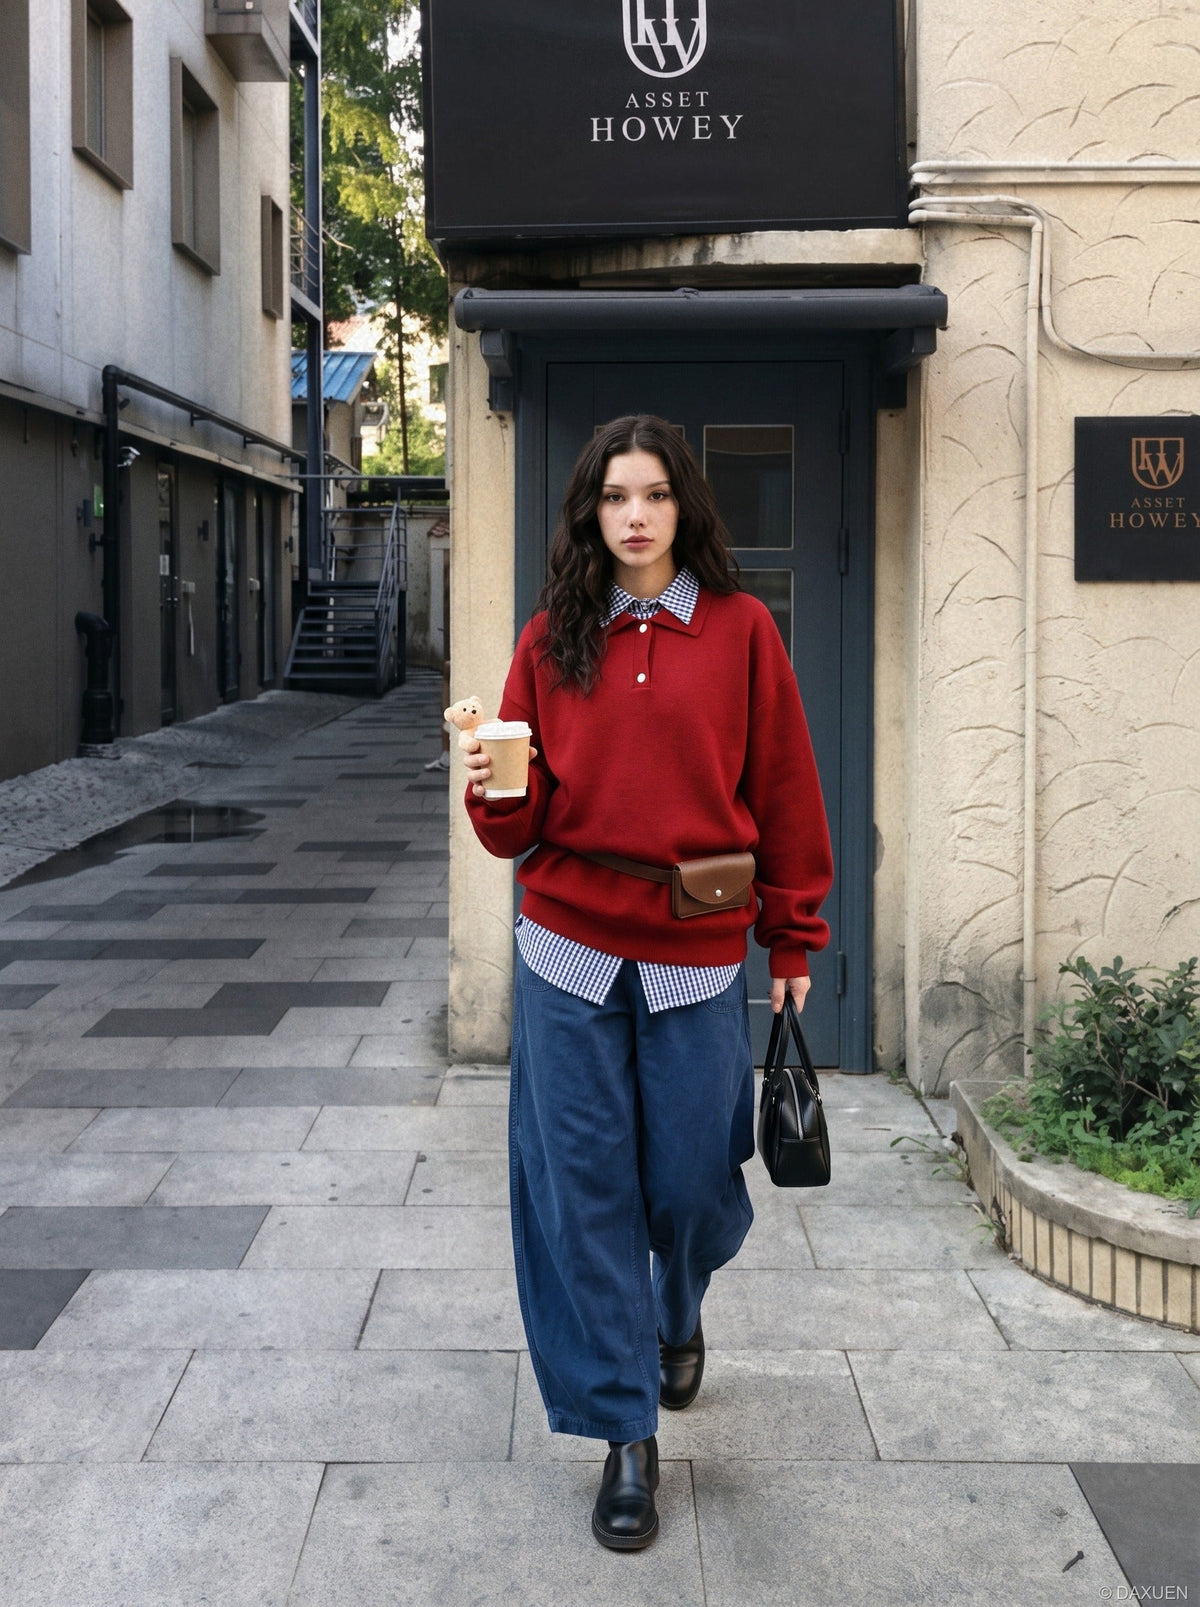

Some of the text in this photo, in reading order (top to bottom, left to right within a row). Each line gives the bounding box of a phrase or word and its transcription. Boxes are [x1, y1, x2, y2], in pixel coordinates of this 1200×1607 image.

[625, 91, 709, 108] ASSET
[590, 114, 743, 142] HOWEY
[1131, 497, 1185, 509] ASSET
